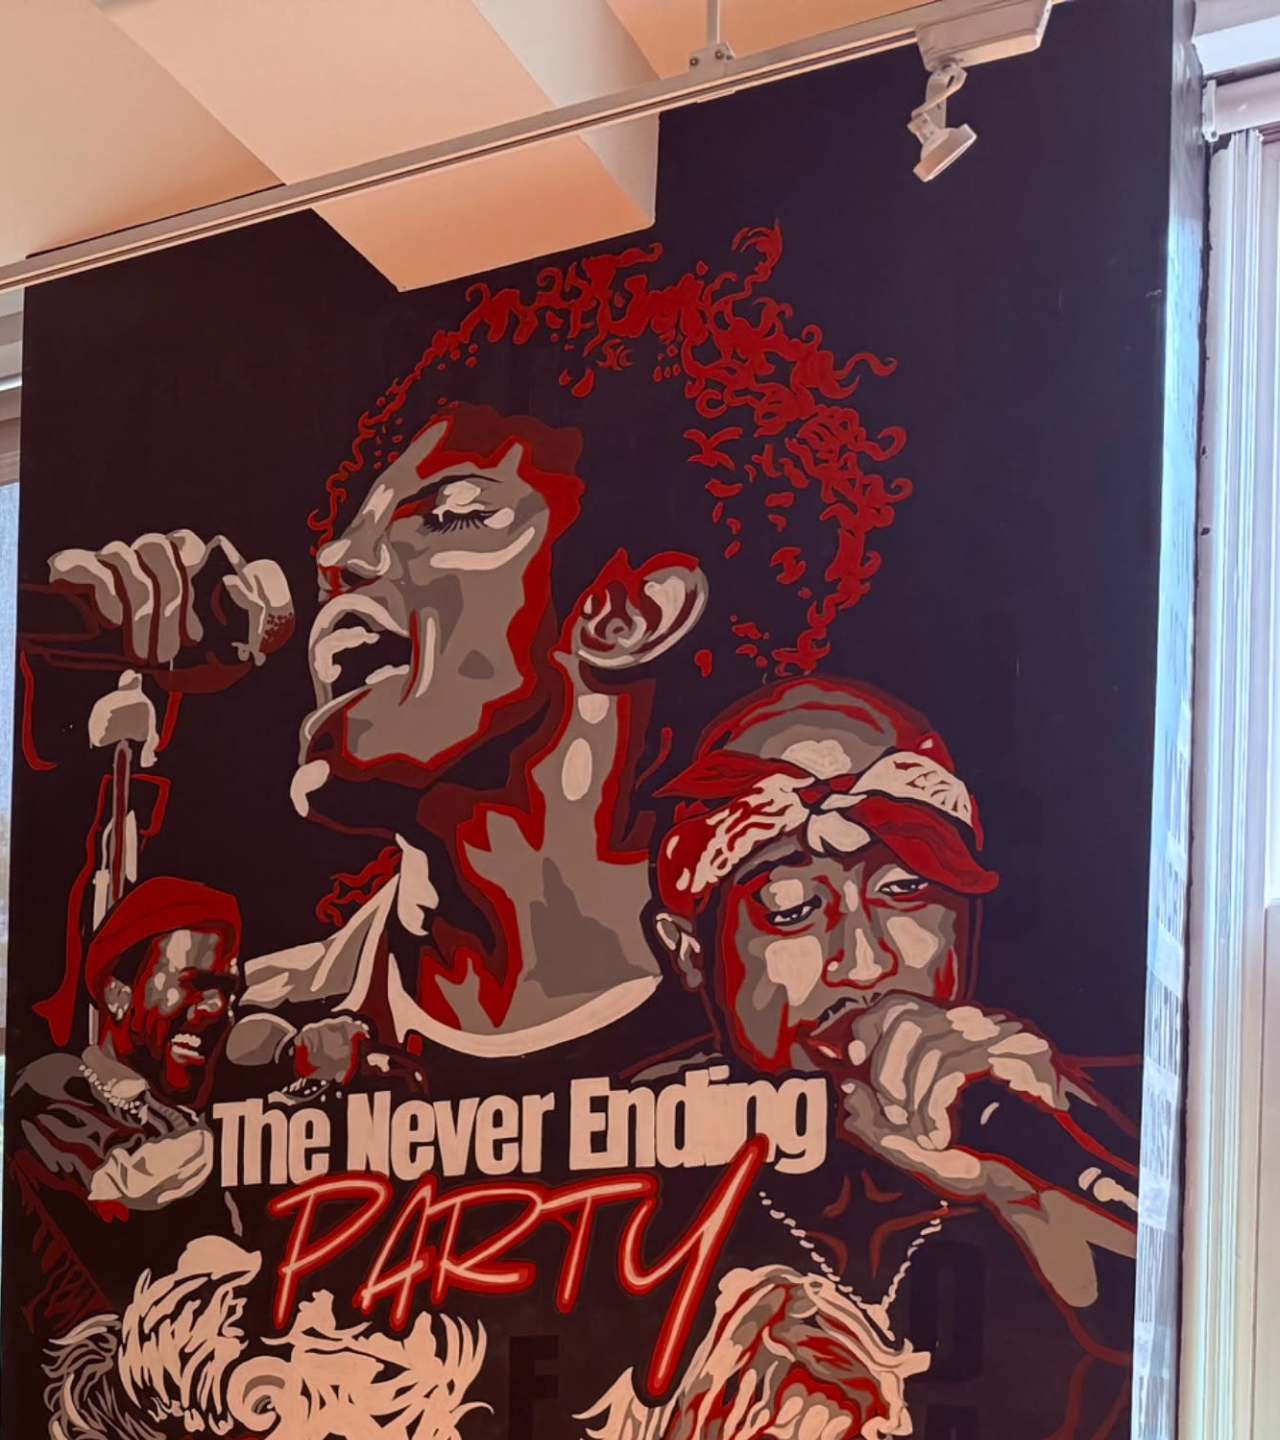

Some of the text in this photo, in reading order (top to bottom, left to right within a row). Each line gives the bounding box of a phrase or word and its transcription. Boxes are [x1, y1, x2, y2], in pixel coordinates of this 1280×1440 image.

[212, 1064, 828, 1187] The Never Ending
[268, 1132, 771, 1398] PARTY
